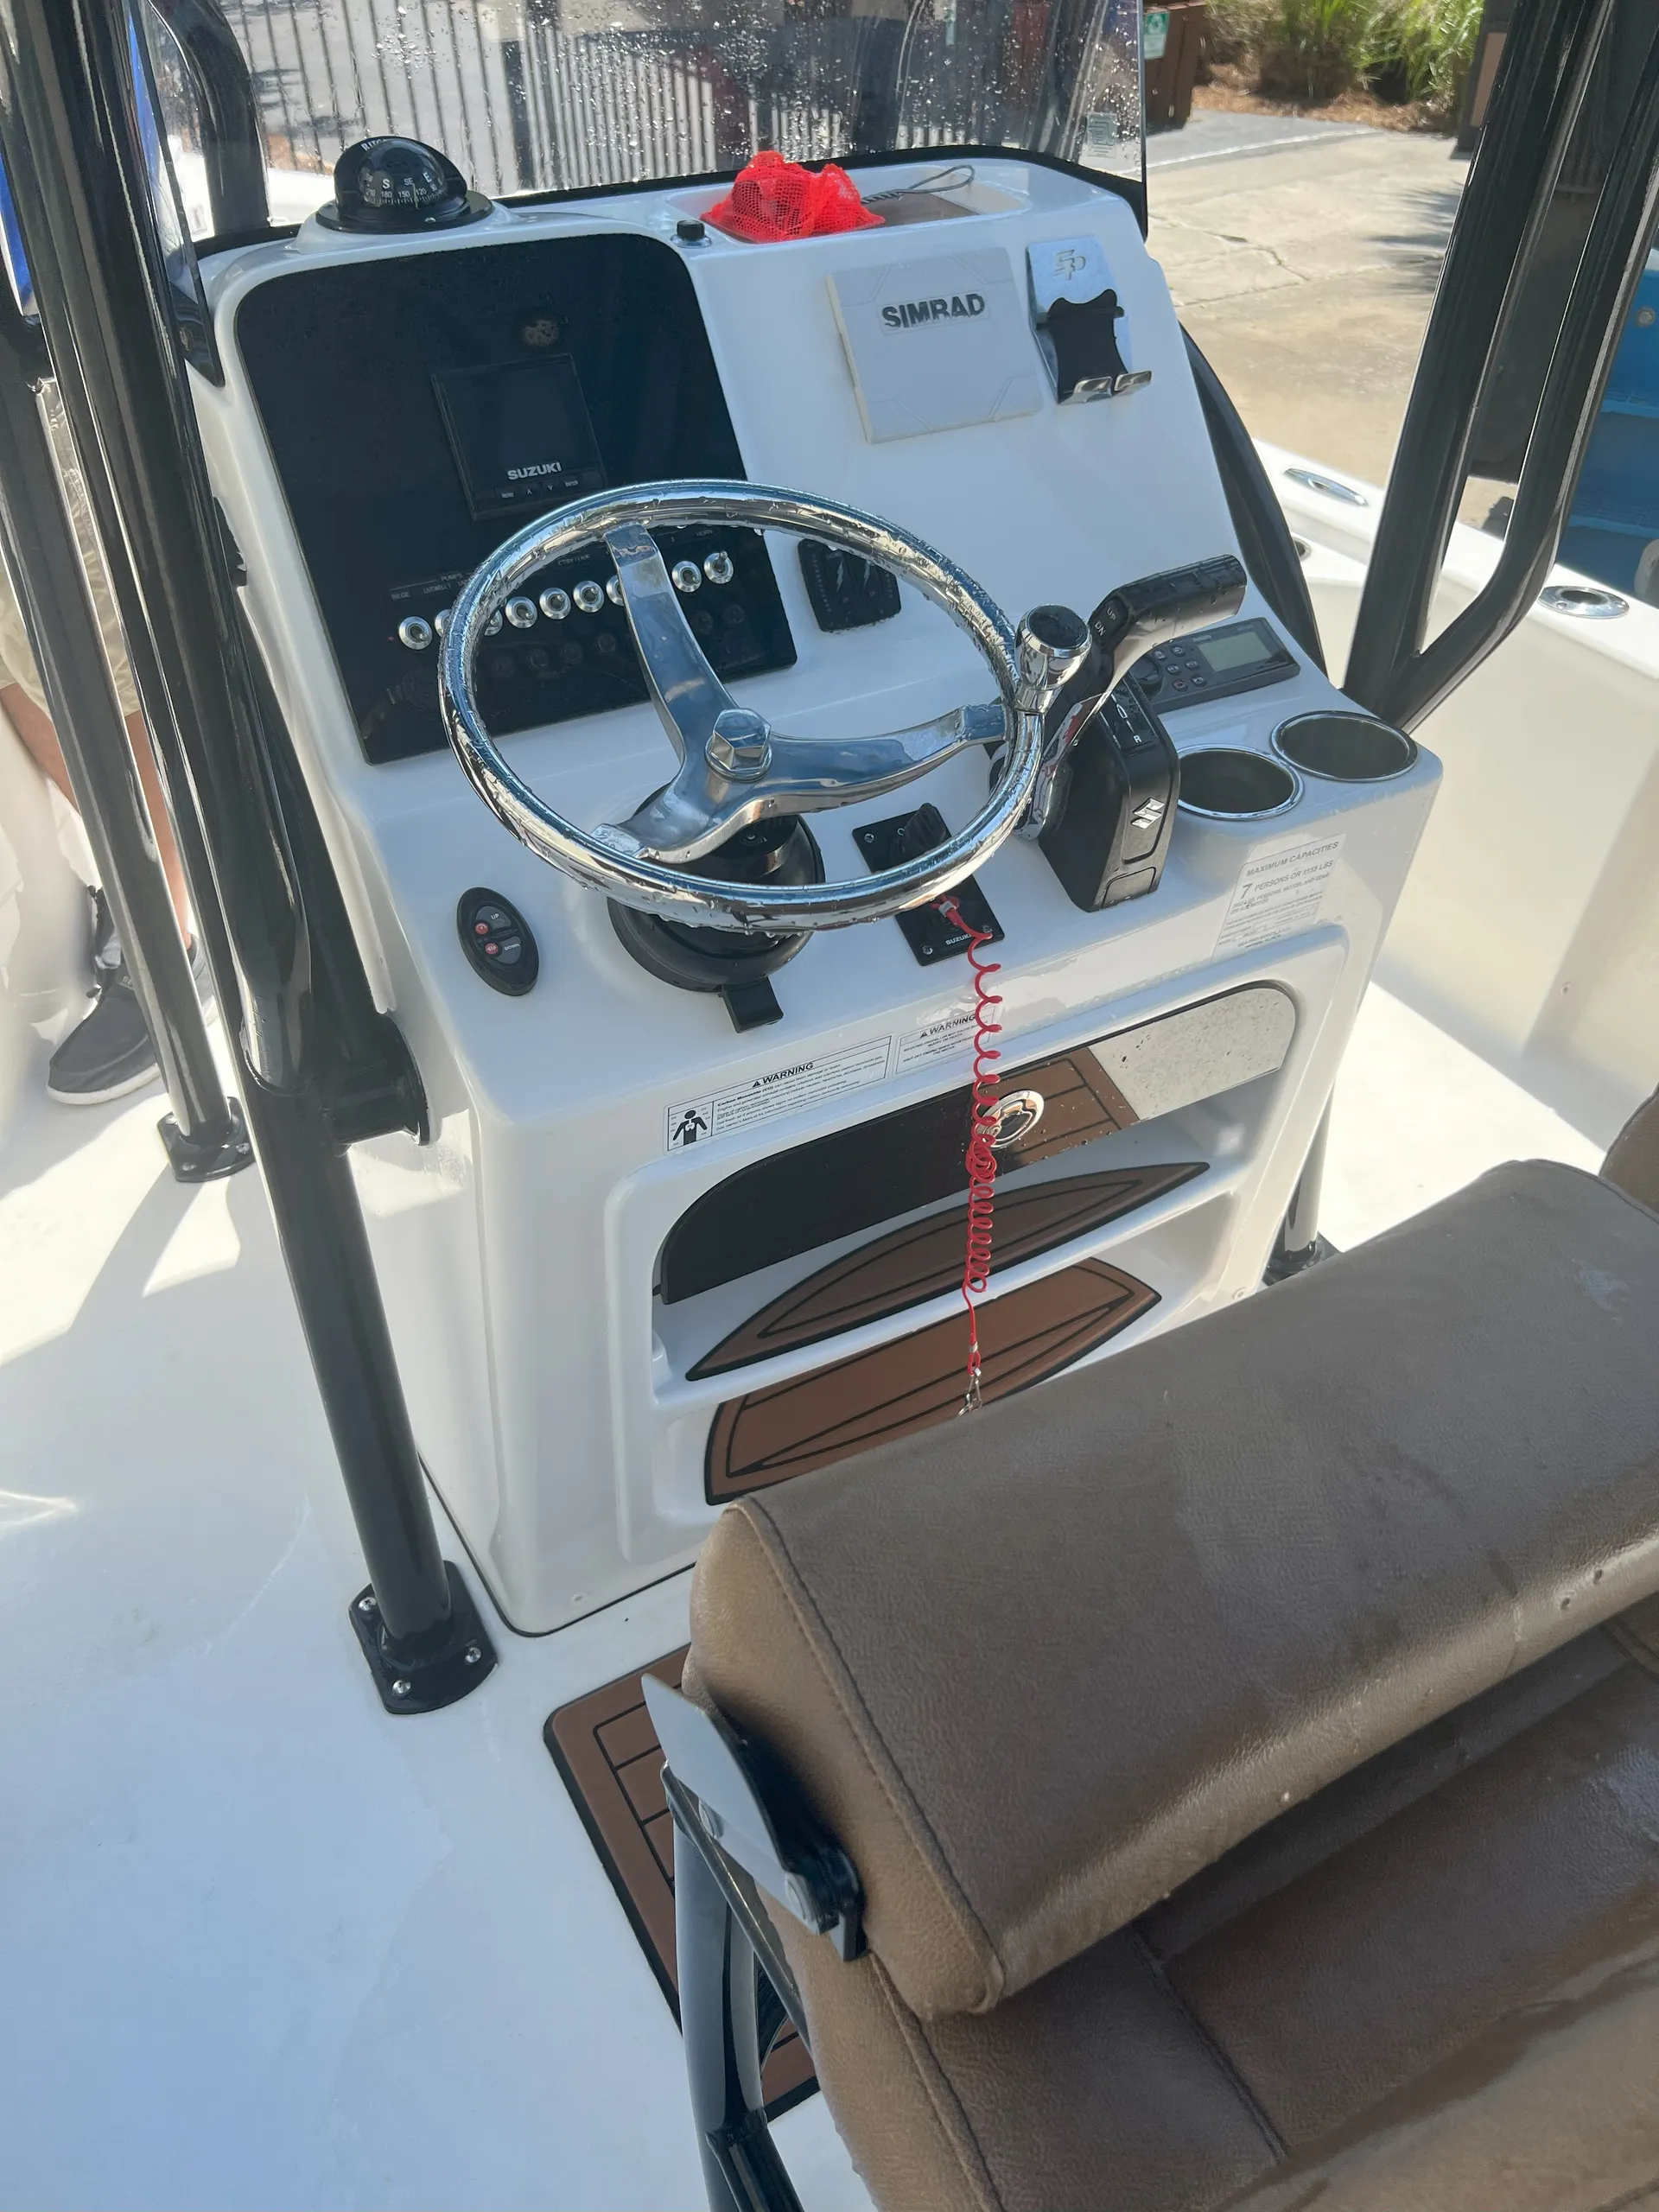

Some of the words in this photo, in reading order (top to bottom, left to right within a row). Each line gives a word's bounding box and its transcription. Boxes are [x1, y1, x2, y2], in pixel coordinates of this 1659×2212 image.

[382, 178, 391, 189] S
[404, 177, 414, 187] SE
[423, 172, 432, 183] E
[381, 190, 392, 199] 180
[398, 190, 410, 199] 150
[416, 188, 427, 196] 120
[881, 293, 986, 328] SIMRAD
[507, 461, 562, 480] SUZUKI
[1107, 607, 1116, 620] UP
[1095, 620, 1106, 636] DN
[1133, 734, 1142, 743] R
[1246, 858, 1287, 876] MAXIMUM
[1289, 842, 1338, 863] CAPACITIES
[1241, 882, 1253, 899] 7
[1255, 874, 1289, 892] PERSONS
[1319, 861, 1333, 870] LBS
[930, 1014, 976, 1034] WARNING
[762, 1062, 814, 1084] WARNING
